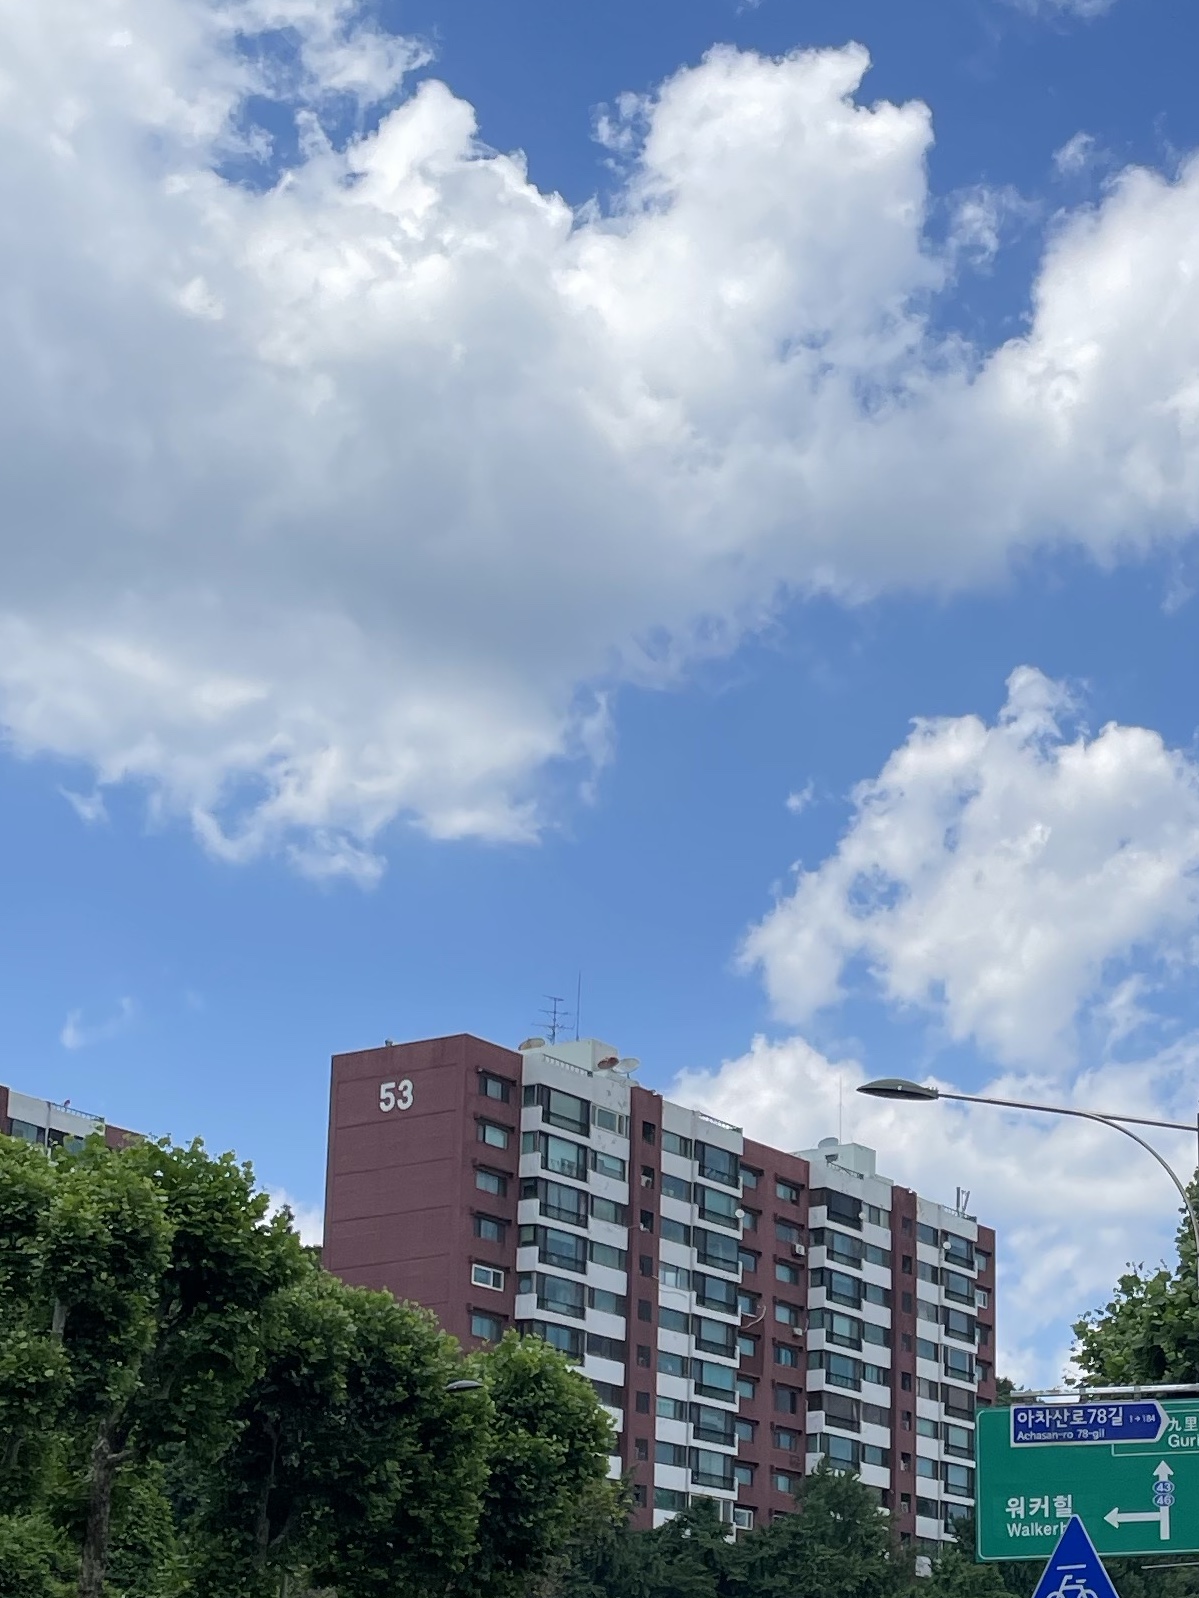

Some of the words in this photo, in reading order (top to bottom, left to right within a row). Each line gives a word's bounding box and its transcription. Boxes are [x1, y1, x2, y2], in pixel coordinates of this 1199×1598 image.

[379, 1079, 414, 1112] 53
[1017, 1406, 1123, 1429] 아차산로78길
[1017, 1430, 1074, 1441] Achasan-ro
[1076, 1428, 1105, 1440] 78-gil
[1156, 1482, 1171, 1492] 43
[1005, 1494, 1073, 1519] 워커힐
[1156, 1495, 1171, 1506] 46
